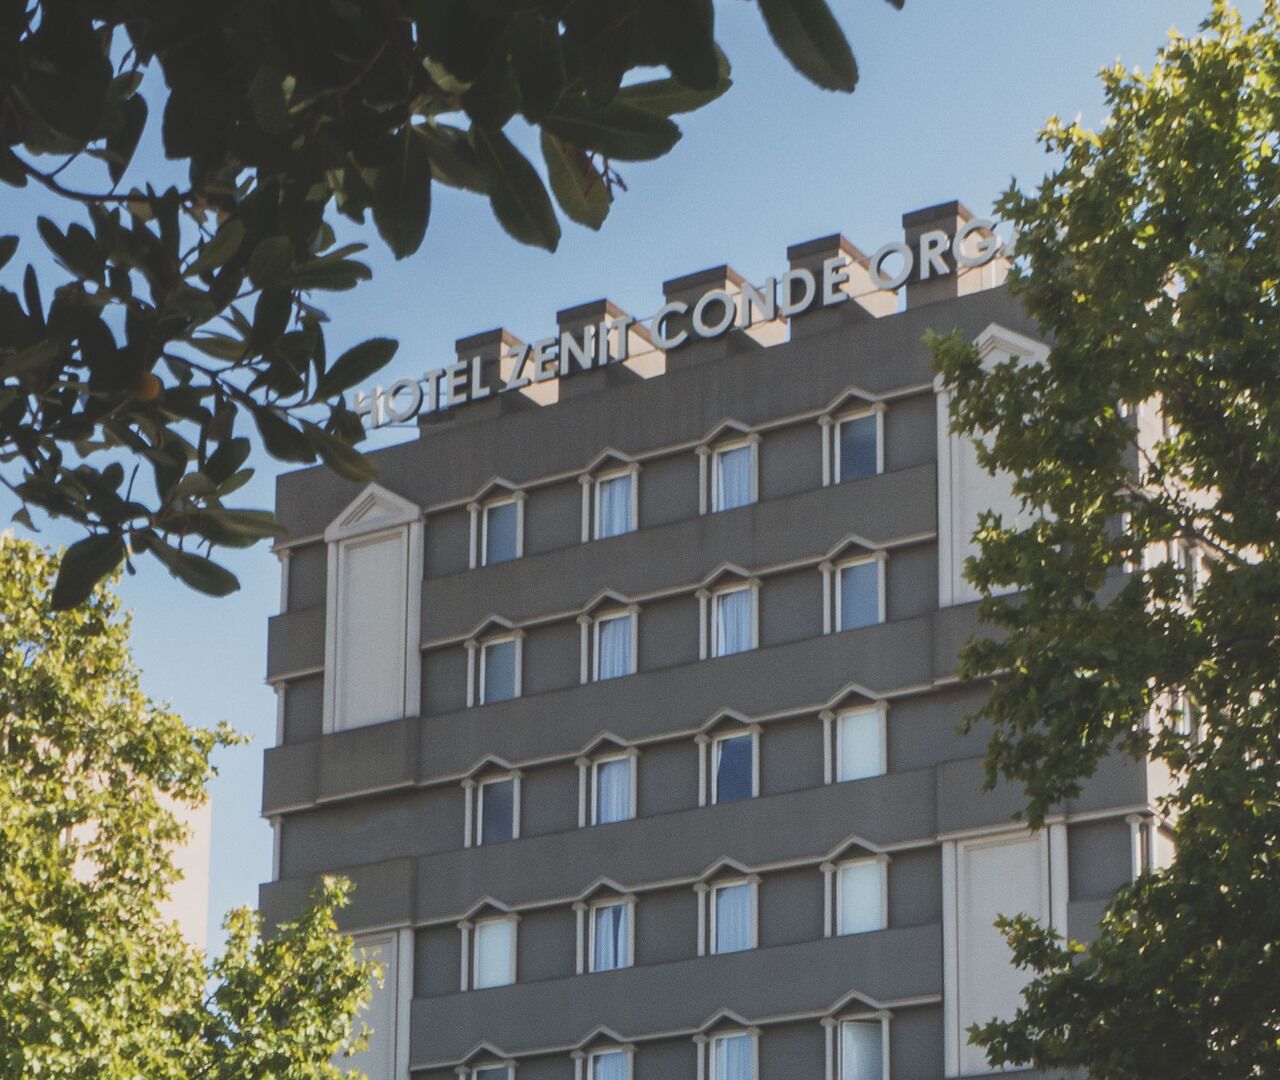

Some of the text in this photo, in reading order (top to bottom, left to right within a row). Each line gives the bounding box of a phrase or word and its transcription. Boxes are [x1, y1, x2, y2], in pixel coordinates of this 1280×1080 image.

[355, 218, 1019, 428] HOTEL ZENIT CONDE ORG
